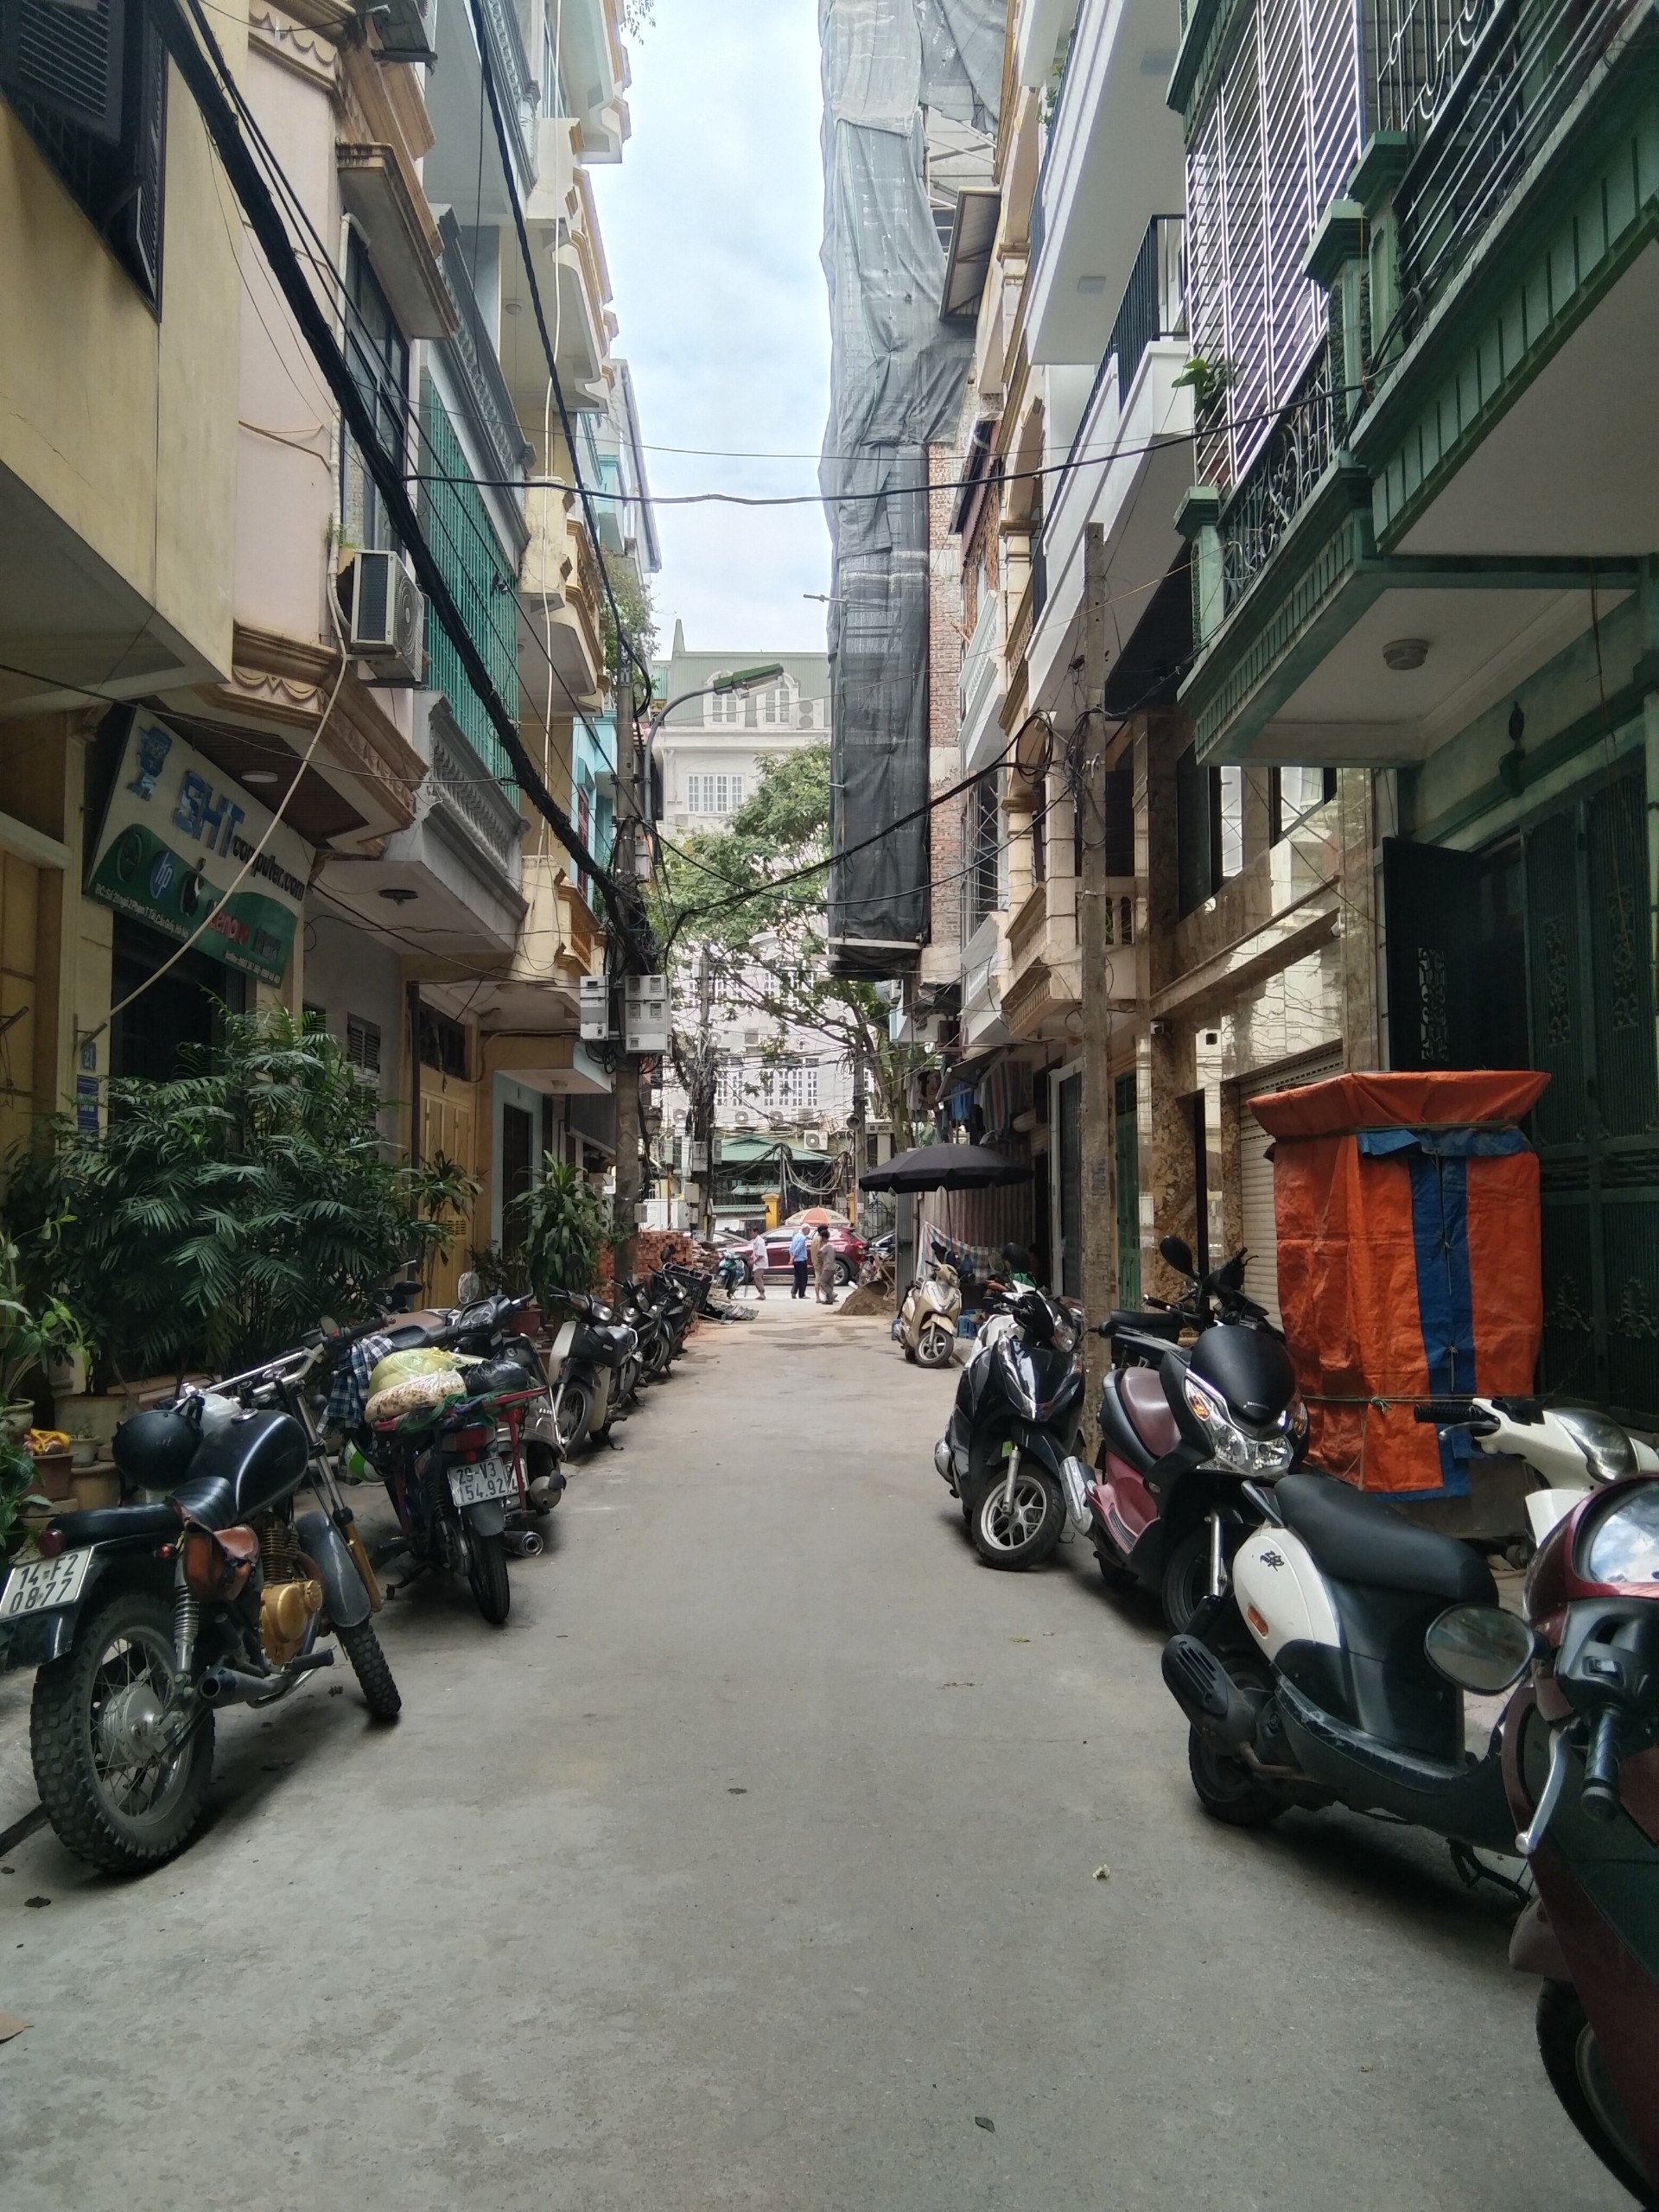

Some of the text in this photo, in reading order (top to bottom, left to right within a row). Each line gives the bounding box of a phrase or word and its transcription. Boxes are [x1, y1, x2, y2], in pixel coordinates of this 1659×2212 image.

[174, 770, 245, 858] SHT
[84, 1047, 93, 1068] 21
[456, 1461, 497, 1485] 29-V3
[456, 1478, 506, 1503] 154.92
[9, 1577, 73, 1614] 0877
